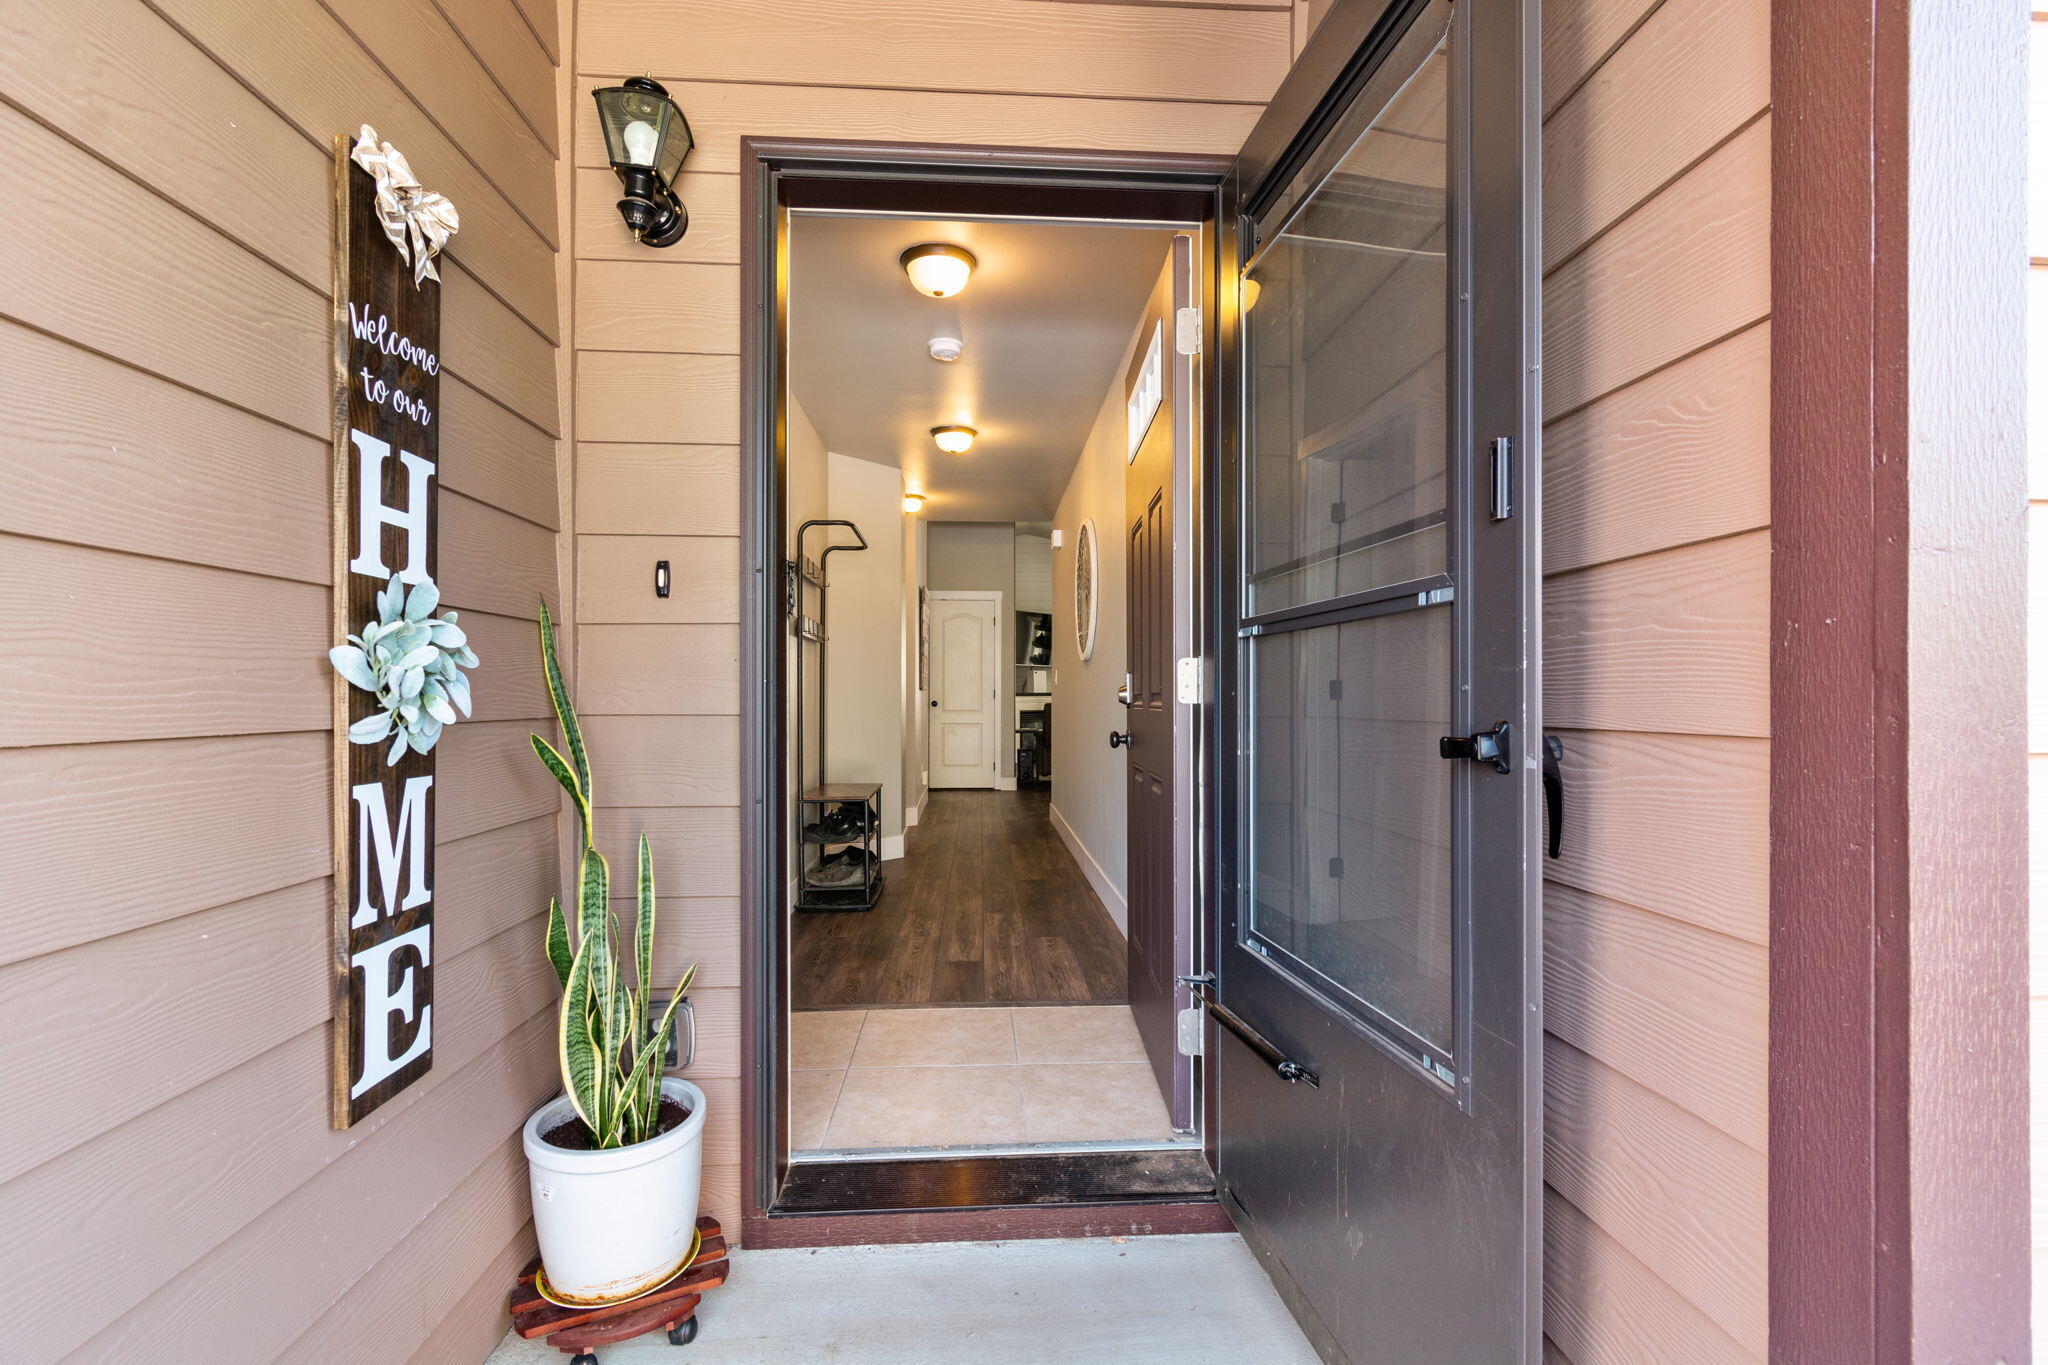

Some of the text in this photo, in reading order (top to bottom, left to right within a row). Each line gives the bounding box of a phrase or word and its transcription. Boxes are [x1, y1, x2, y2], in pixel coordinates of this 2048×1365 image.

[349, 302, 440, 376] Welcome
[360, 367, 432, 426] to our
